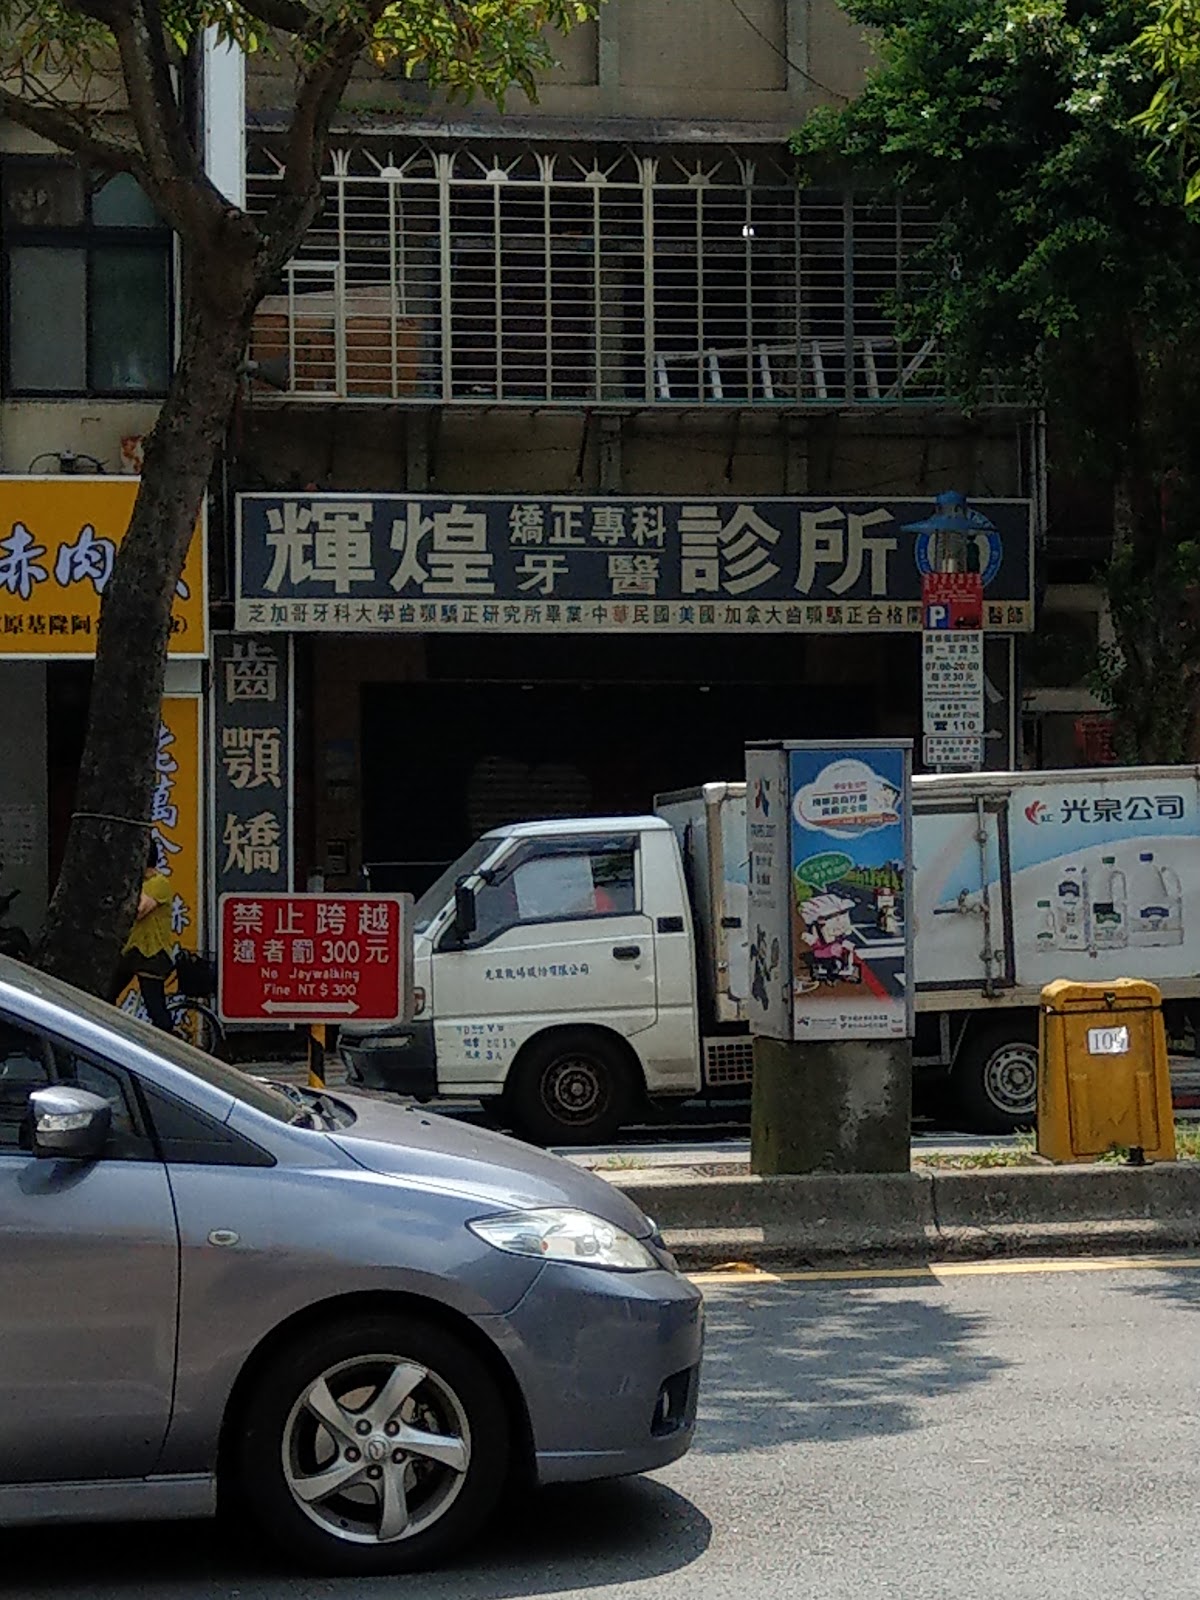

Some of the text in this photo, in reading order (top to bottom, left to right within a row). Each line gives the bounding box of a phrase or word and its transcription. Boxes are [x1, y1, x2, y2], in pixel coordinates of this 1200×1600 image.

[508, 503, 667, 547] 矯正專科
[262, 502, 495, 595] 輝煌
[677, 504, 899, 596] 診所
[514, 553, 661, 596] 牙醫
[929, 605, 947, 628] P
[953, 720, 976, 731] 110
[221, 638, 283, 876] 齒顎矯
[1060, 794, 1185, 824] 光泉公司
[233, 902, 389, 935] 禁止跨越
[233, 938, 389, 964] 違者罰300元
[261, 967, 360, 982] No Jaywalking
[263, 984, 291, 996] Fine
